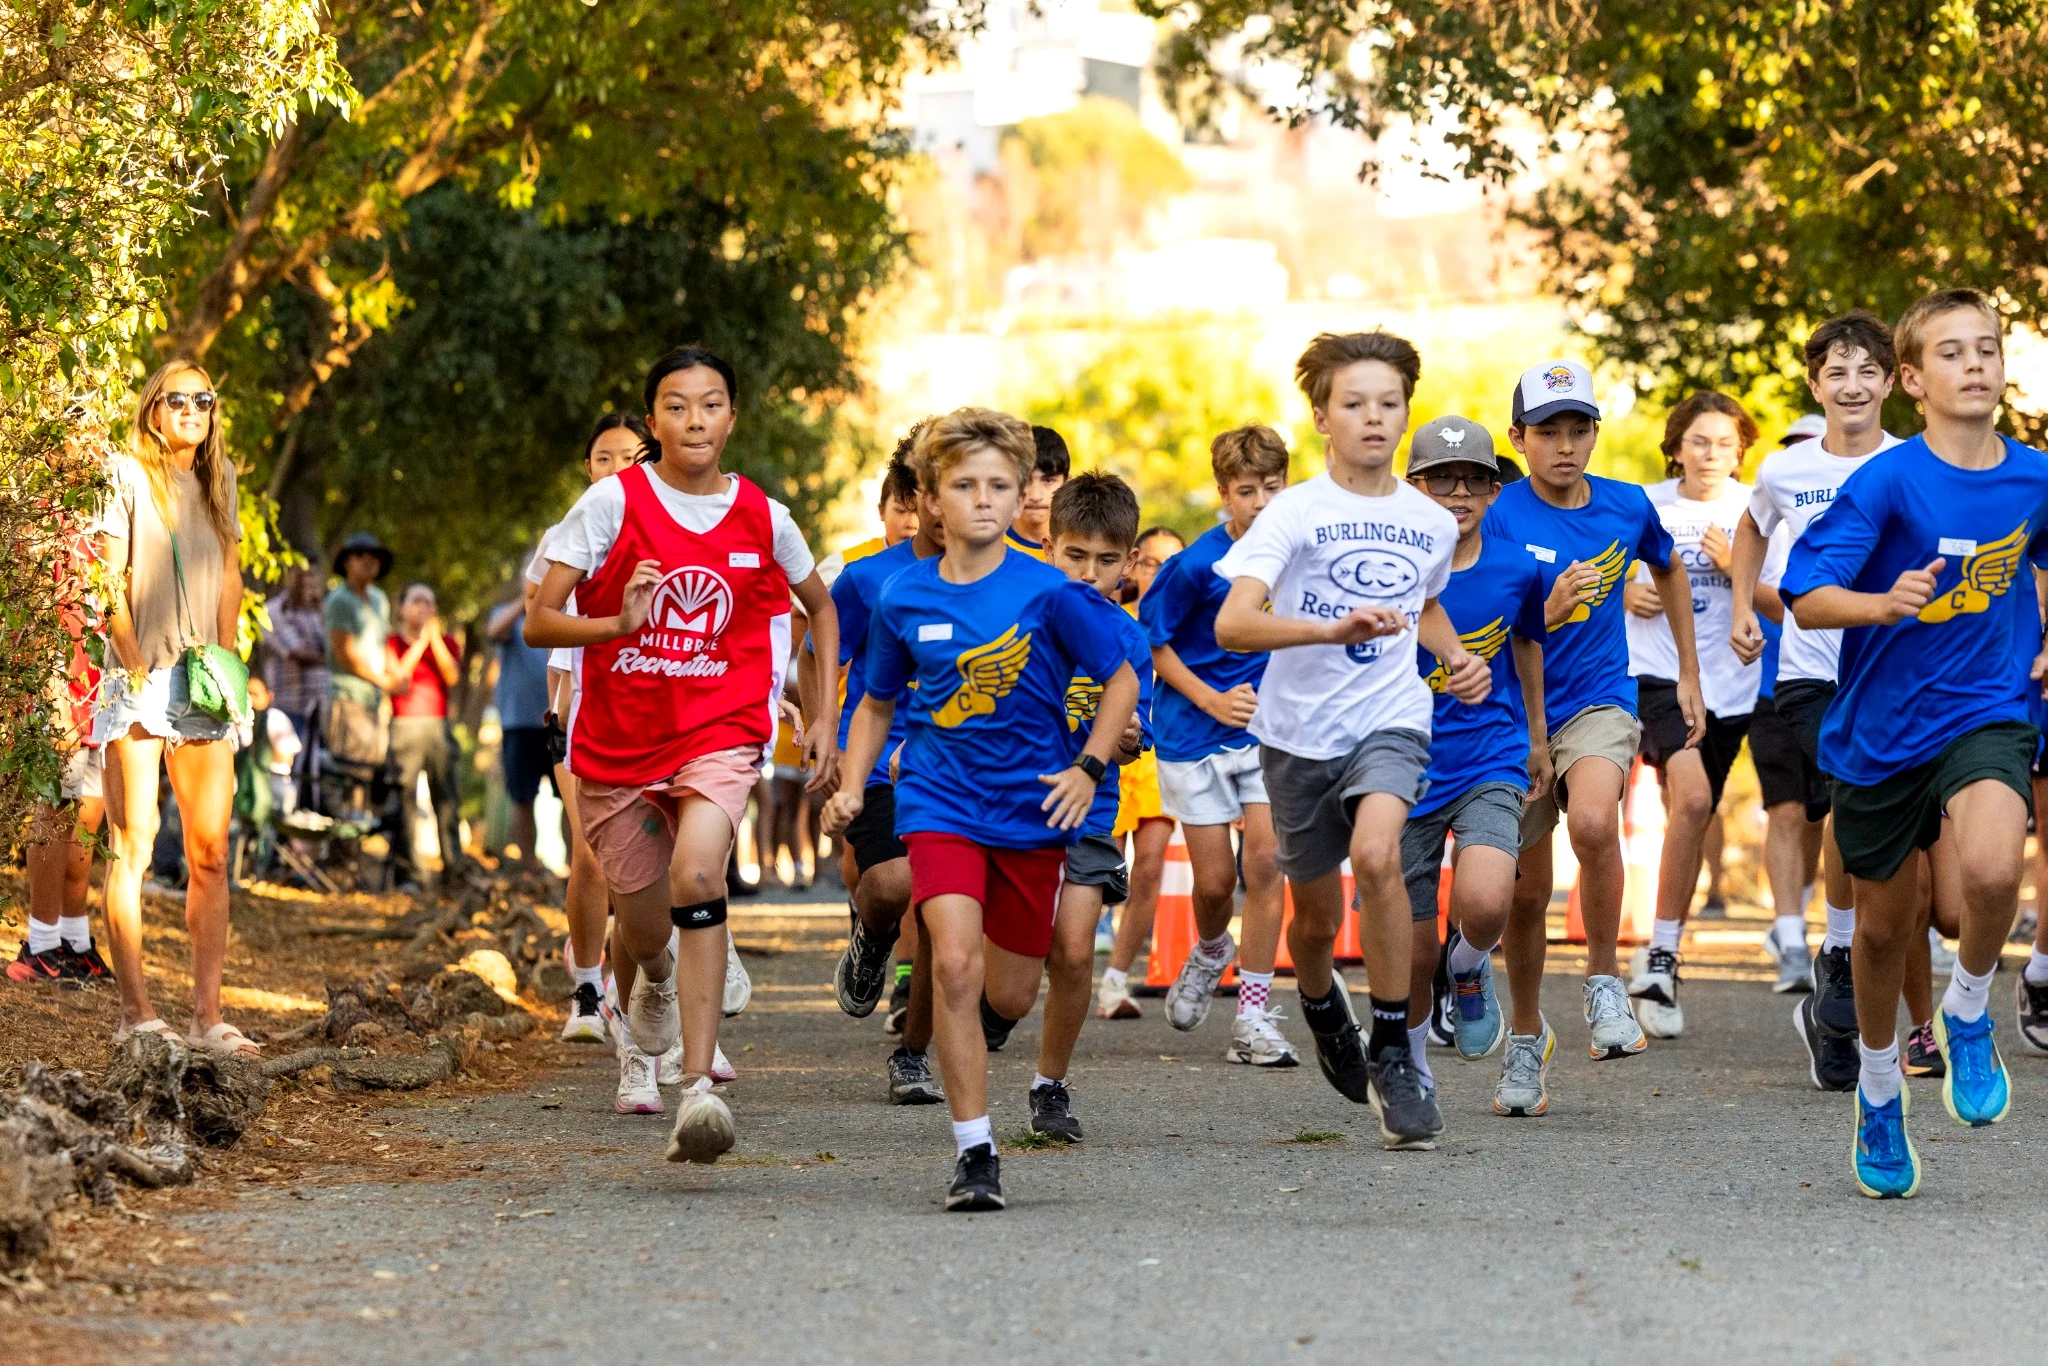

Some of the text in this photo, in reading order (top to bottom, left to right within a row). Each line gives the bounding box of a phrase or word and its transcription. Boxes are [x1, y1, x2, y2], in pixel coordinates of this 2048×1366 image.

[1315, 522, 1434, 554] BURLINGAME
[1951, 590, 1966, 610] C
[639, 633, 719, 653] MILLBRAE
[610, 647, 729, 678] Recreation
[958, 692, 972, 712] C
